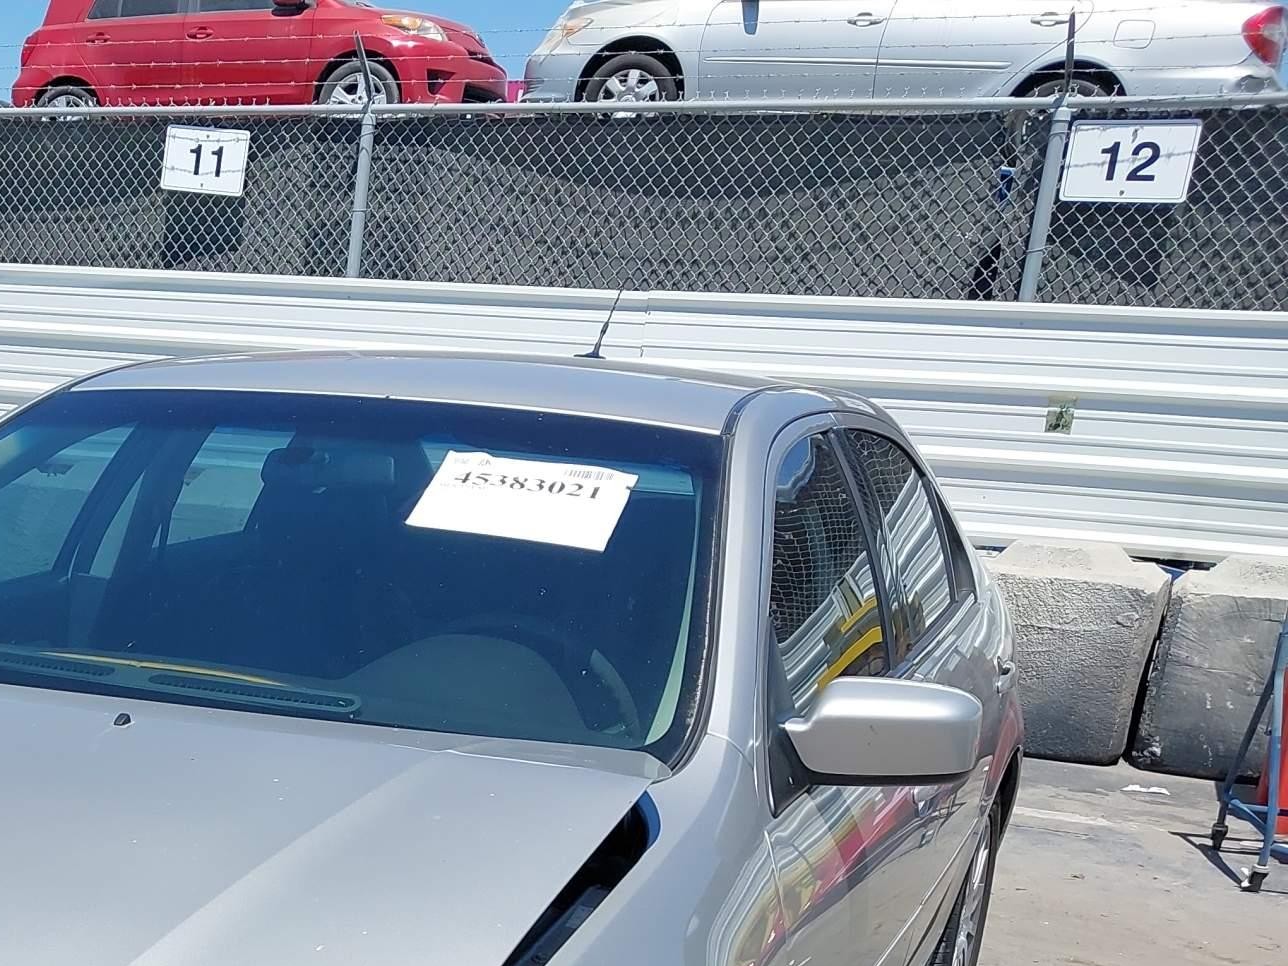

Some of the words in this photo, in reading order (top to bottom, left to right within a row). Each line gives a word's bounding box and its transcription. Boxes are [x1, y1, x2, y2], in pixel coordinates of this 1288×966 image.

[189, 143, 225, 178] 11
[1100, 141, 1161, 182] 12
[454, 471, 600, 499] 45383021
